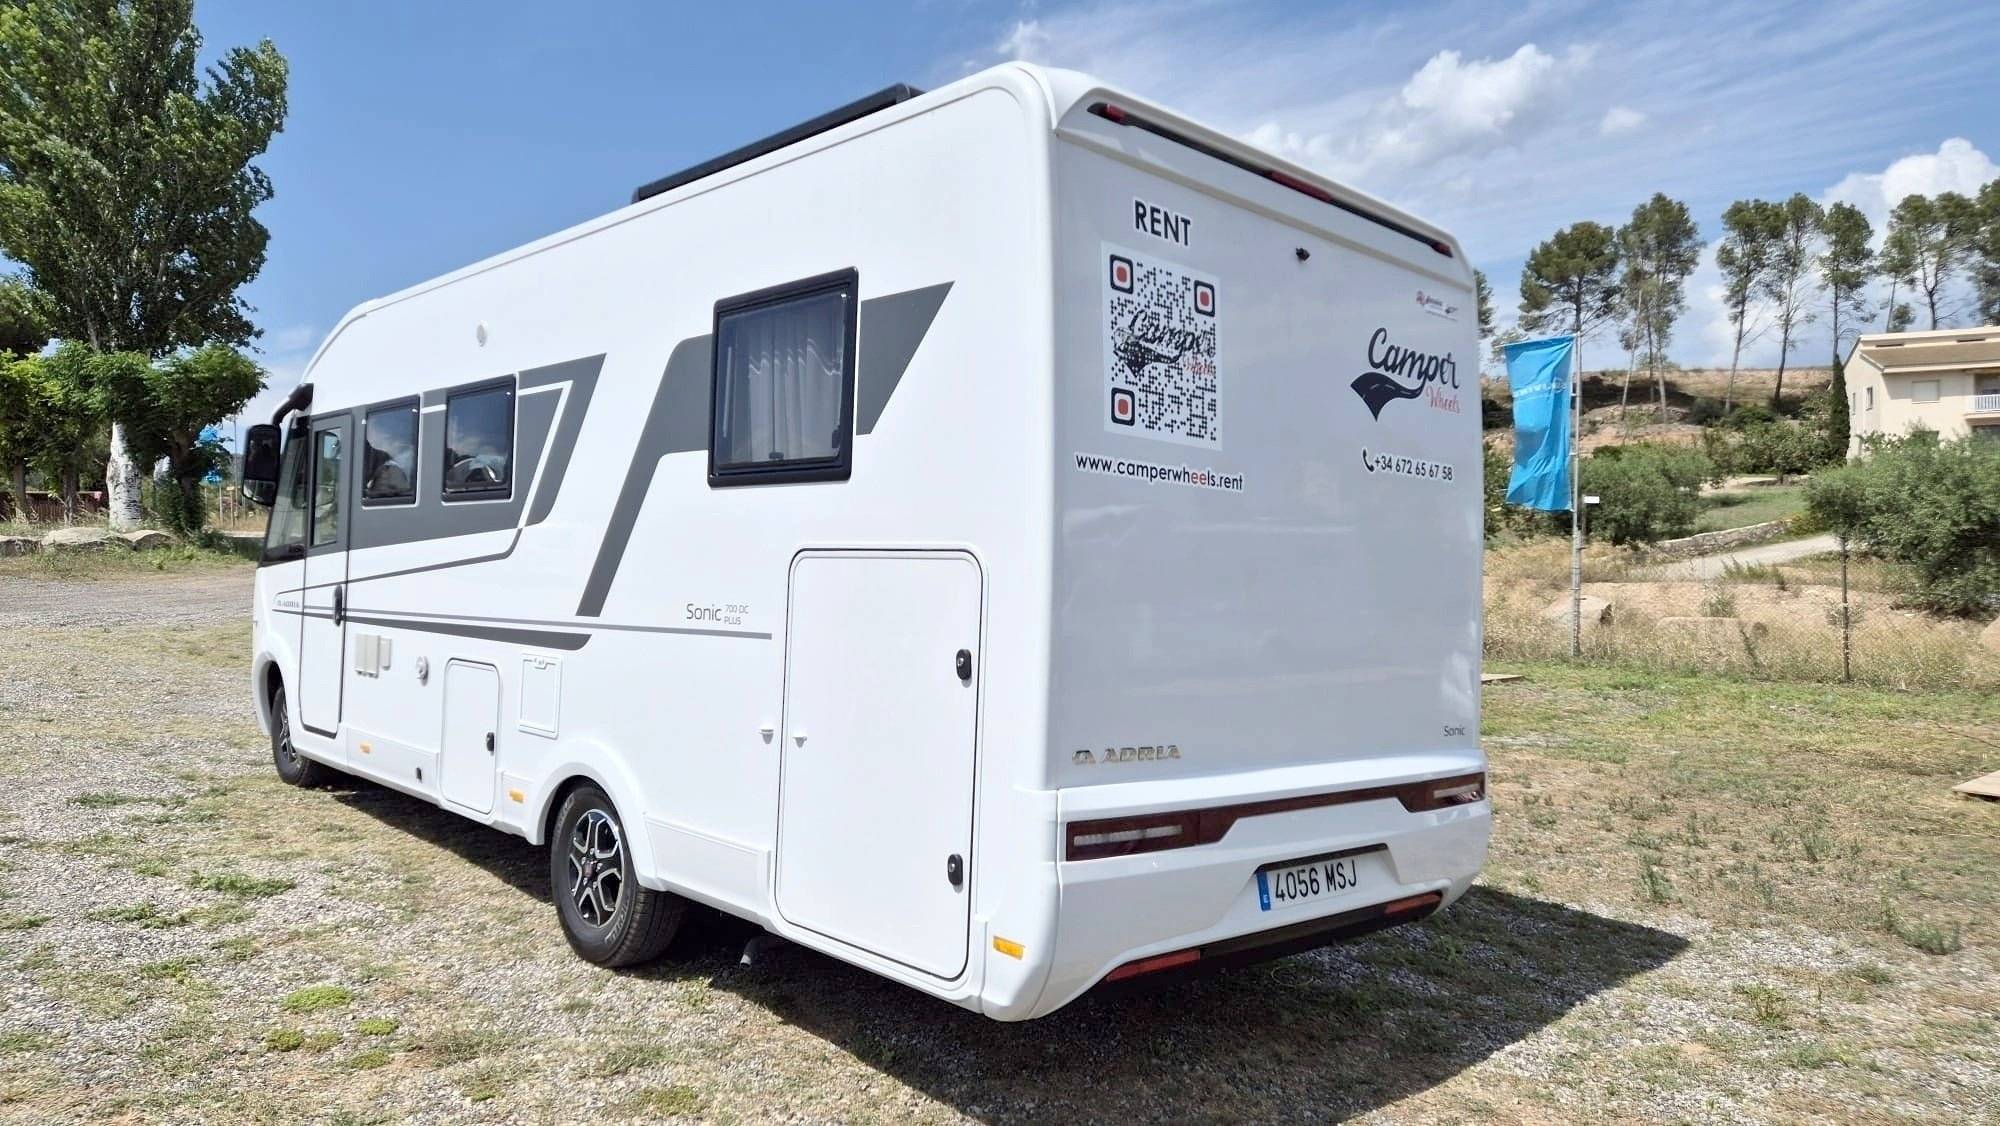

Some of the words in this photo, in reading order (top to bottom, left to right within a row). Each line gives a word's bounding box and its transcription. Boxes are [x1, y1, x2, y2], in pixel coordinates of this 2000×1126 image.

[1134, 199, 1191, 247] RENT
[1368, 327, 1460, 390] Camper
[1425, 385, 1460, 414] Wheels
[1075, 455, 1243, 490] www.camperwheels.rent
[1375, 455, 1393, 471] +34
[1395, 458, 1413, 475] 672
[1415, 462, 1427, 477] 65
[1428, 464, 1440, 479] 67
[1442, 465, 1453, 481] 58
[686, 603, 722, 622] Sonic
[723, 615, 742, 626] PLUS
[1443, 724, 1466, 737] Sonic
[1102, 744, 1181, 764] ADRIA
[1275, 867, 1320, 902] 4056
[1324, 859, 1357, 893] MSJ
